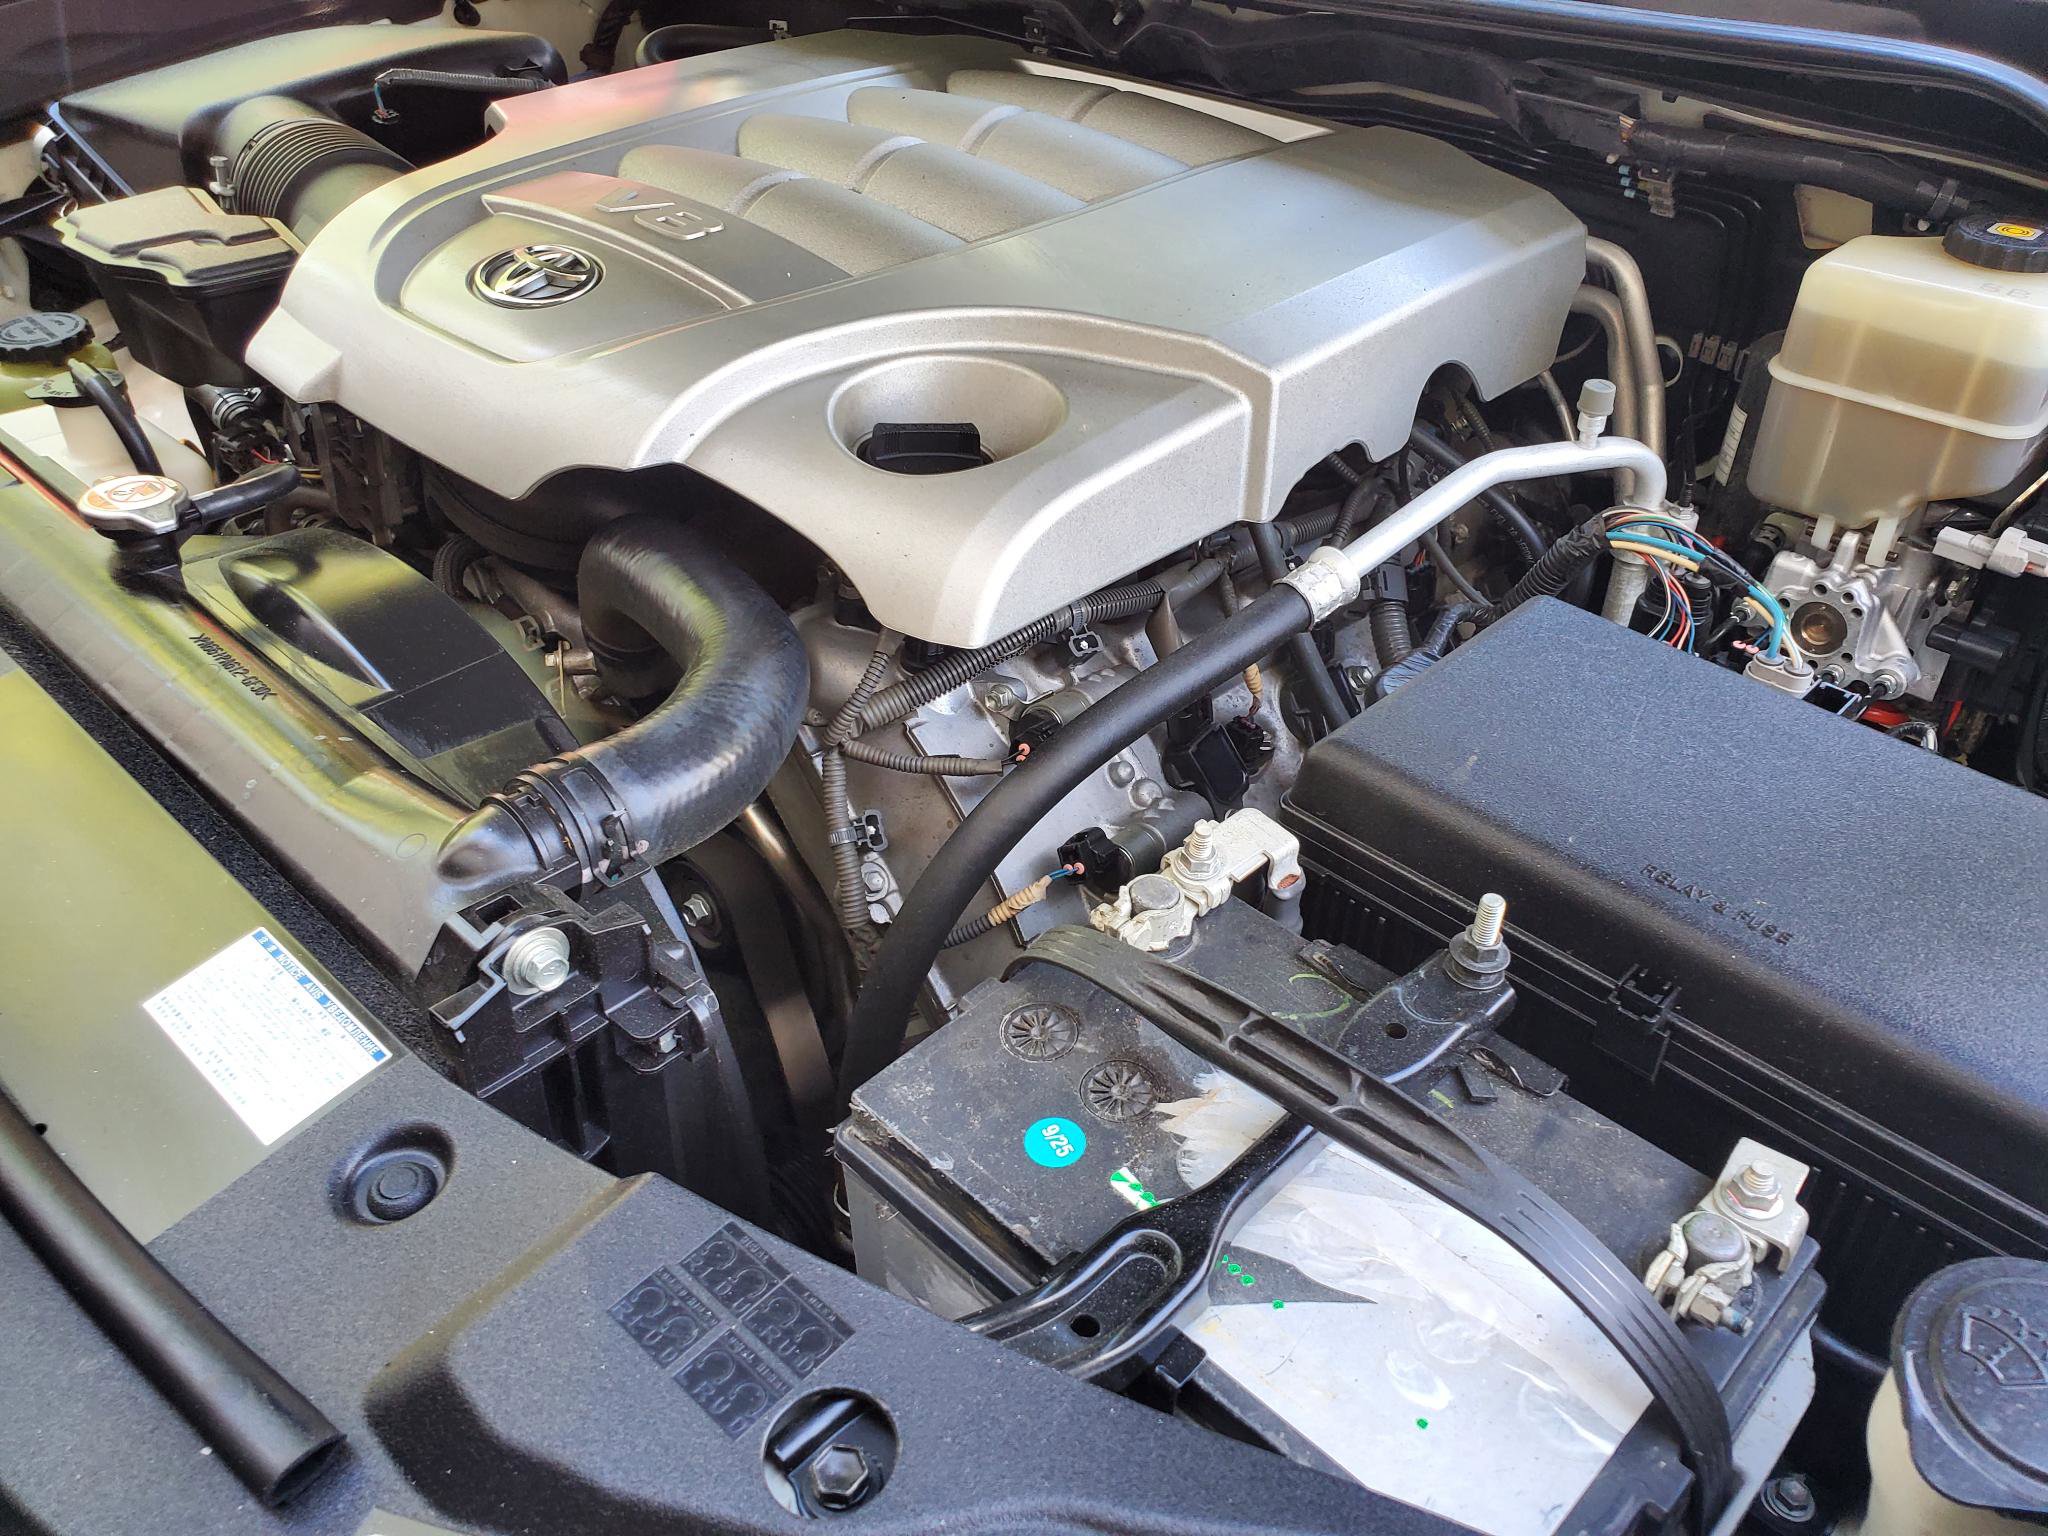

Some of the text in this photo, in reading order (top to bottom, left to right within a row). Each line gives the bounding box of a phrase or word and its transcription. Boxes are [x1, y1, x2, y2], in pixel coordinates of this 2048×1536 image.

[593, 190, 724, 241] V8
[1640, 864, 1793, 945] RELAY & FUSE
[280, 952, 380, 1056] NOTICE AVIS УВЕДОМЛЕНИЕ
[1041, 1123, 1076, 1159] 9/25
